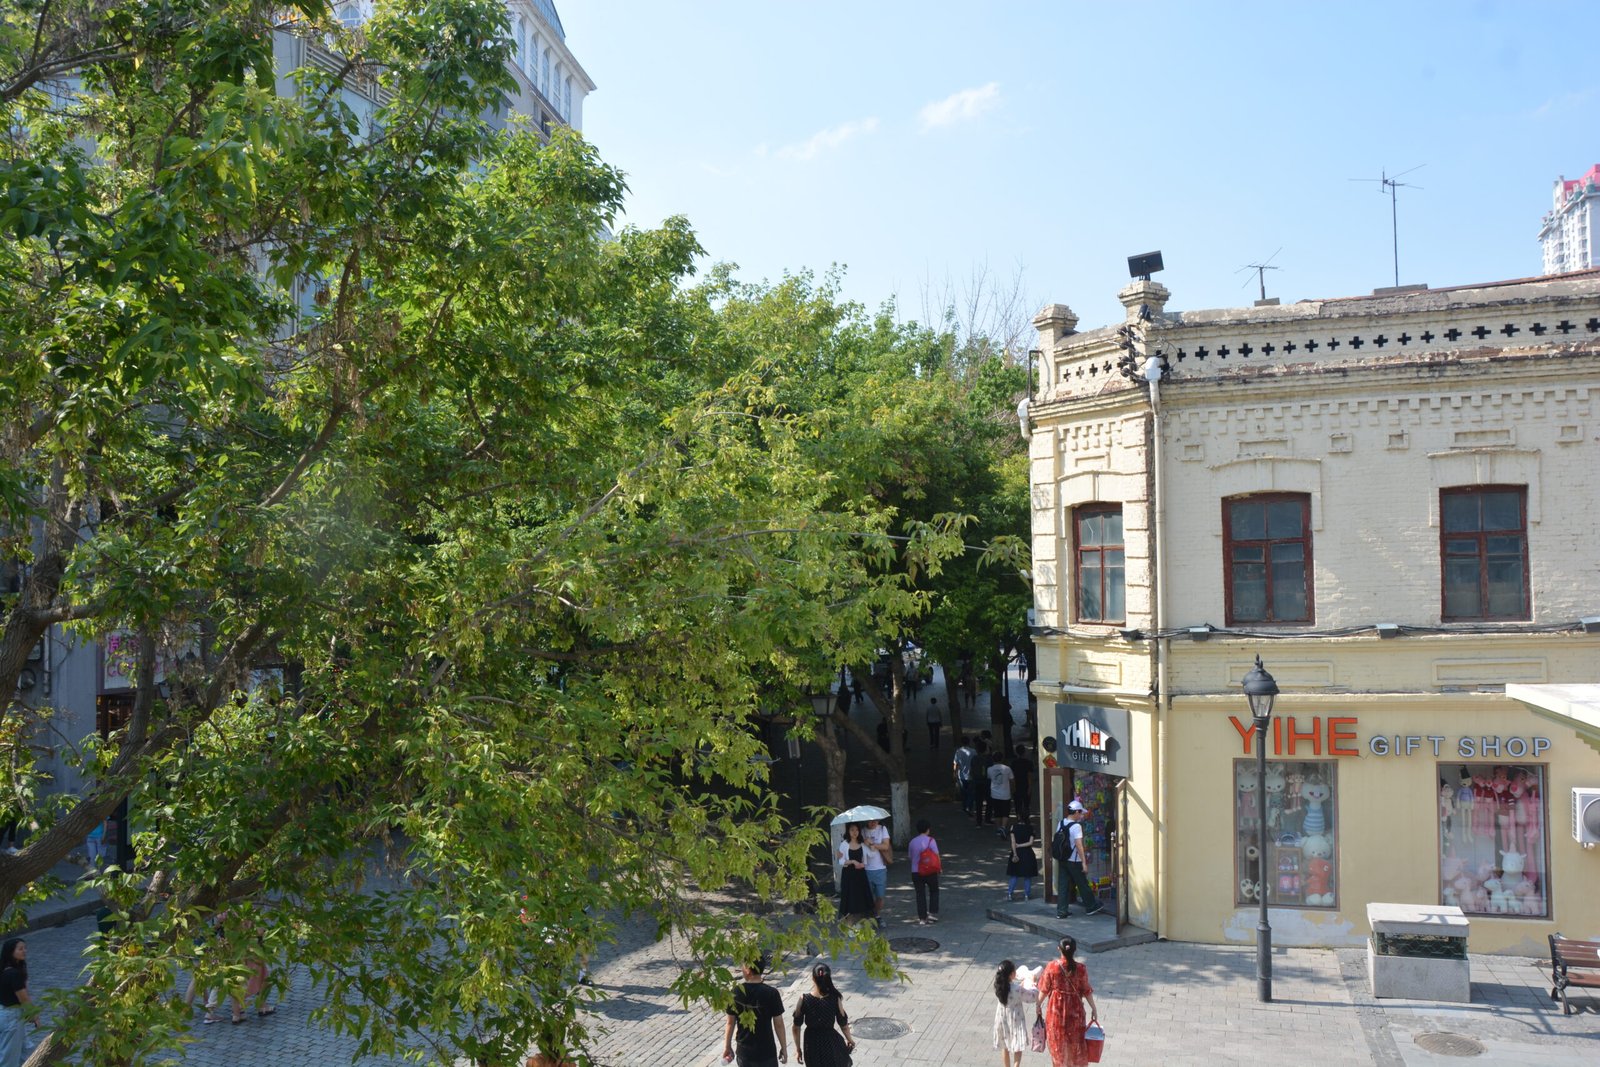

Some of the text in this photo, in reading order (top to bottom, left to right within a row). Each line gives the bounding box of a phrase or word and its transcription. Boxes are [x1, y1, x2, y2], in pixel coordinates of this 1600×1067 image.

[1228, 716, 1552, 758] YIHE GIFT SHOP
